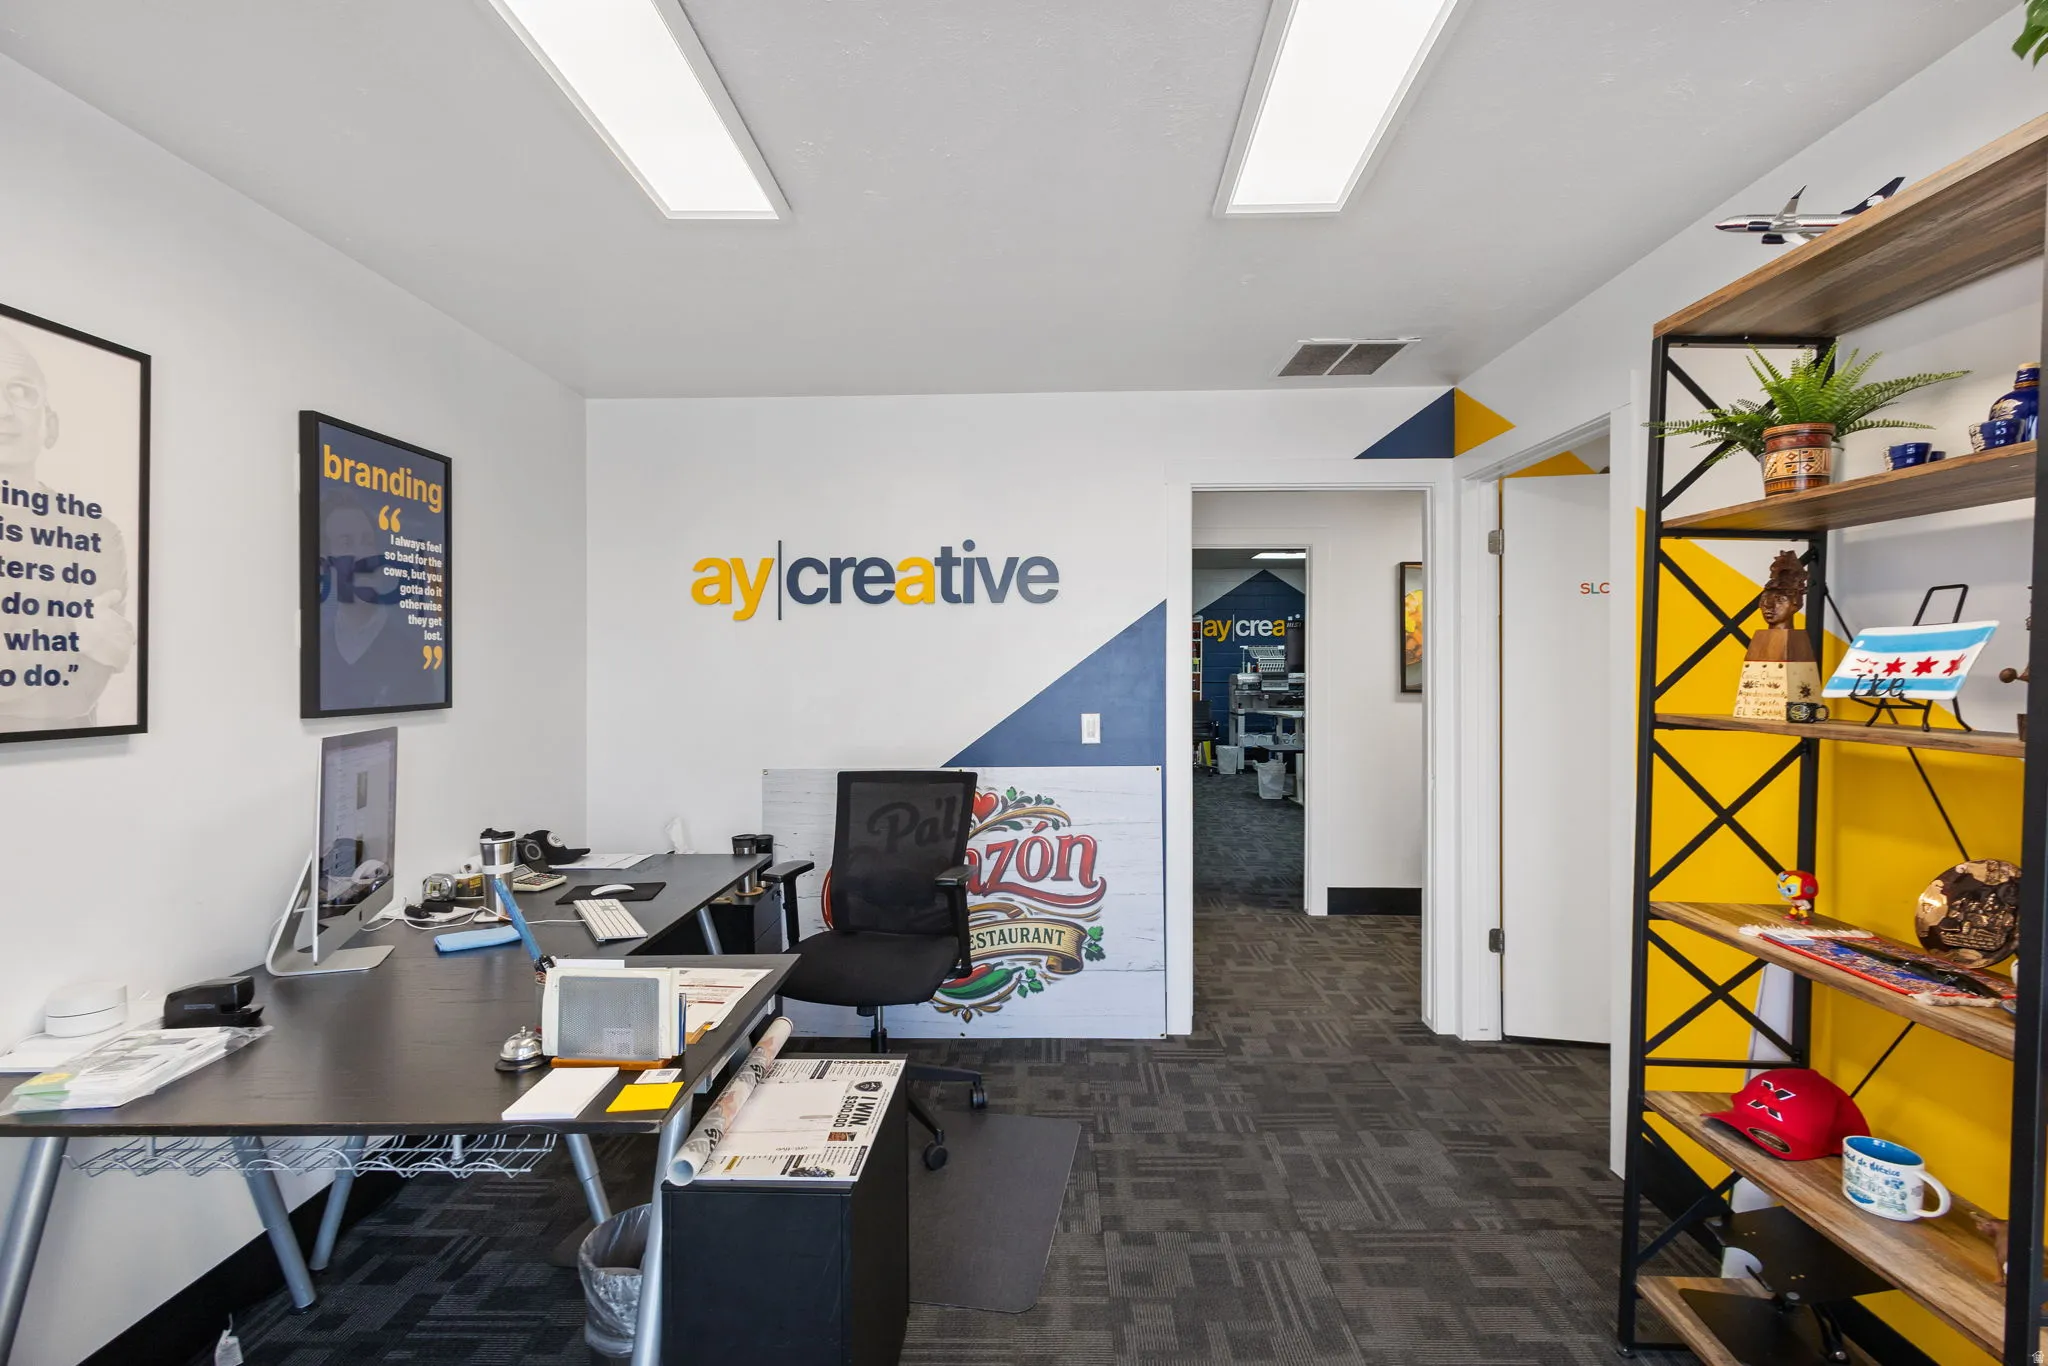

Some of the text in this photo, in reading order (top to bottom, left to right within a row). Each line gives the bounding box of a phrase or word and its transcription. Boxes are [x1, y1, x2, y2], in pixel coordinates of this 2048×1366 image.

[323, 444, 443, 513] branding
[55, 493, 102, 519] the
[30, 526, 102, 553] what
[390, 534, 442, 553] I always feel
[384, 551, 442, 568] so bad for the
[62, 562, 97, 586] do
[383, 567, 442, 583] cows, but you
[400, 585, 442, 597] gotta do it
[1, 592, 95, 619] do not
[399, 599, 442, 611] otherwise
[408, 615, 442, 628] they get
[3, 628, 80, 652] what
[424, 630, 443, 641] lost.
